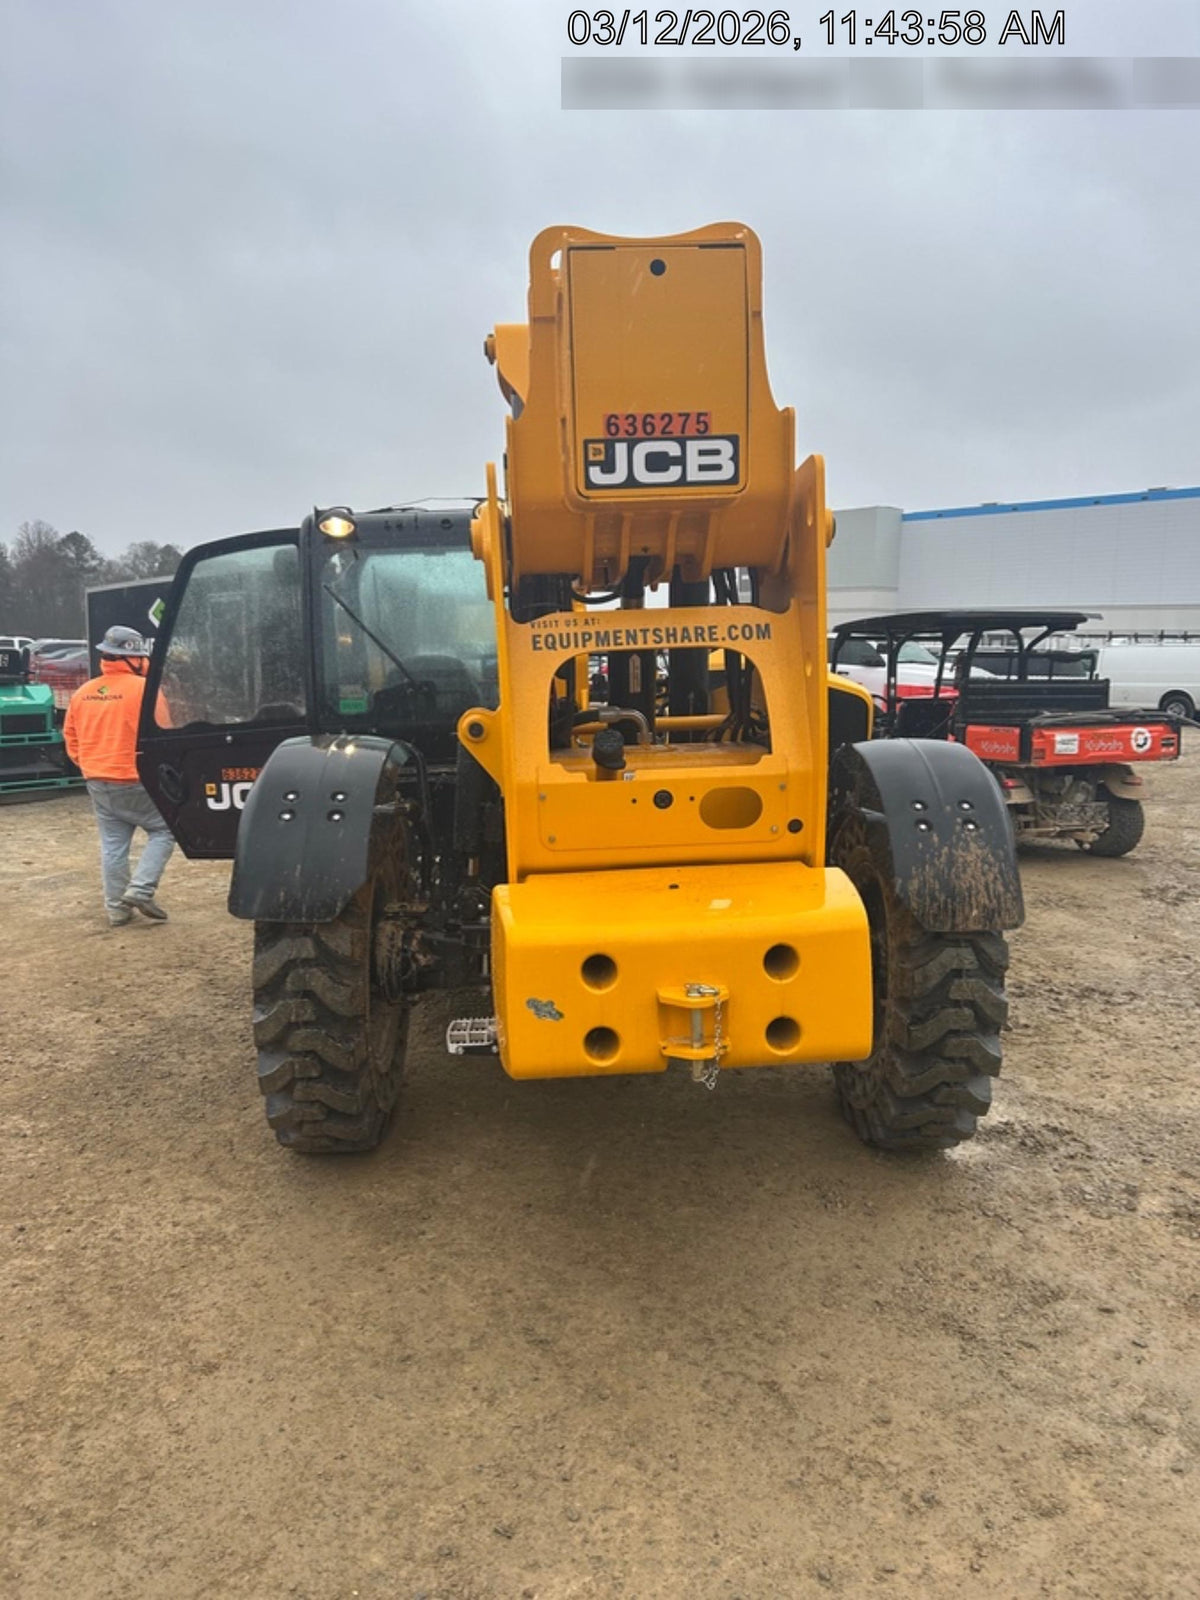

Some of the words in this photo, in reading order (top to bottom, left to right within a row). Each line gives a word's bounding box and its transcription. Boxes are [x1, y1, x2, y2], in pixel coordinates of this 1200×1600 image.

[605, 412, 710, 436] 636275
[587, 438, 736, 486] JCB
[530, 619, 559, 629] VISIT
[564, 618, 578, 627] US
[583, 617, 600, 626] AT:
[531, 623, 772, 651] EQUIPMENTSHARE.COM
[206, 782, 254, 810] JC
